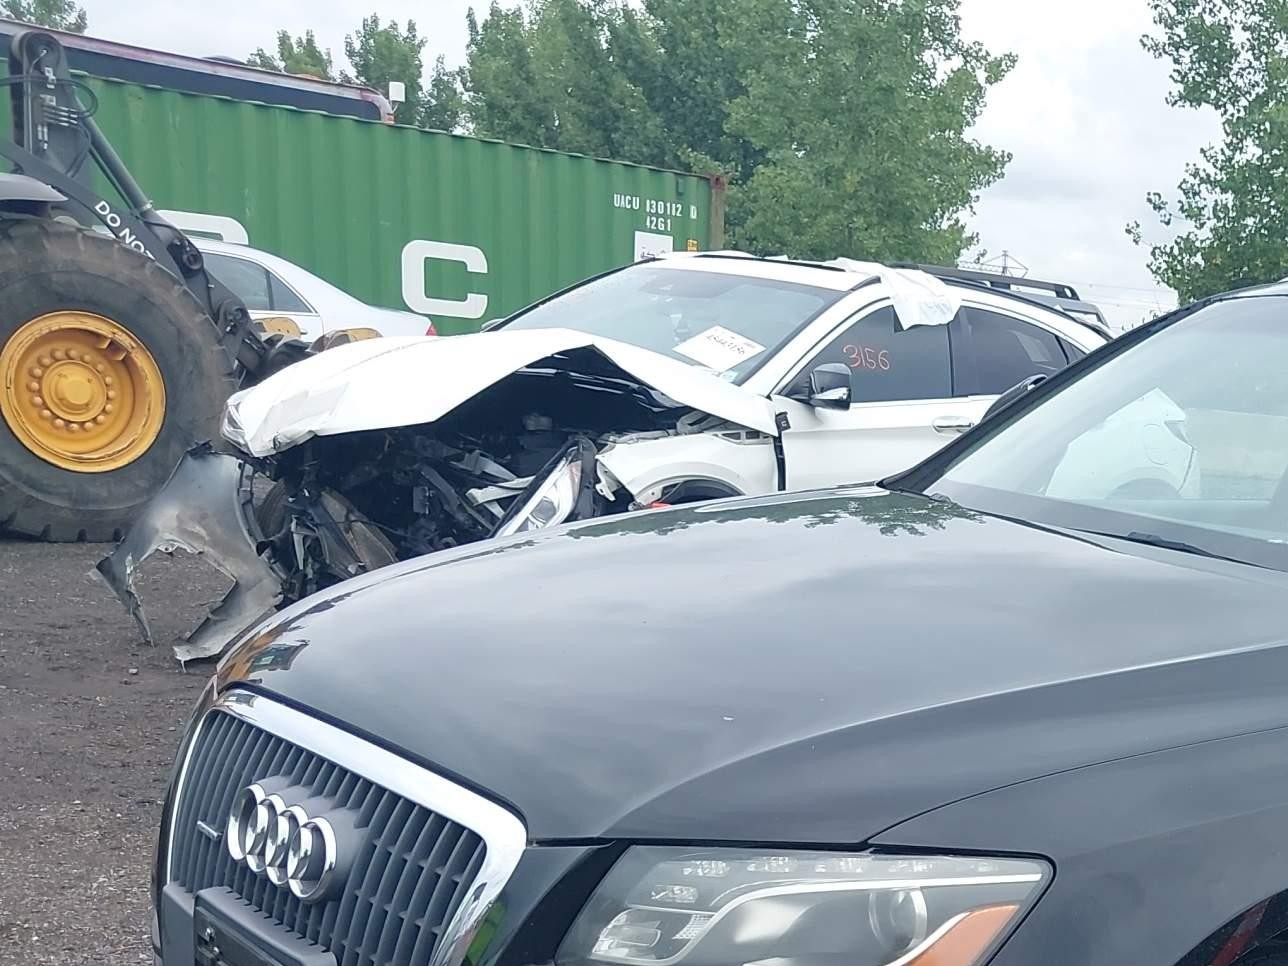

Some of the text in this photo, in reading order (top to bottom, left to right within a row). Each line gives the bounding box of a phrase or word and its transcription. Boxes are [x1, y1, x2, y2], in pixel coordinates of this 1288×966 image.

[94, 200, 121, 227] DO
[613, 193, 640, 210] UACU
[401, 239, 489, 319] C
[843, 344, 890, 370] 3156
